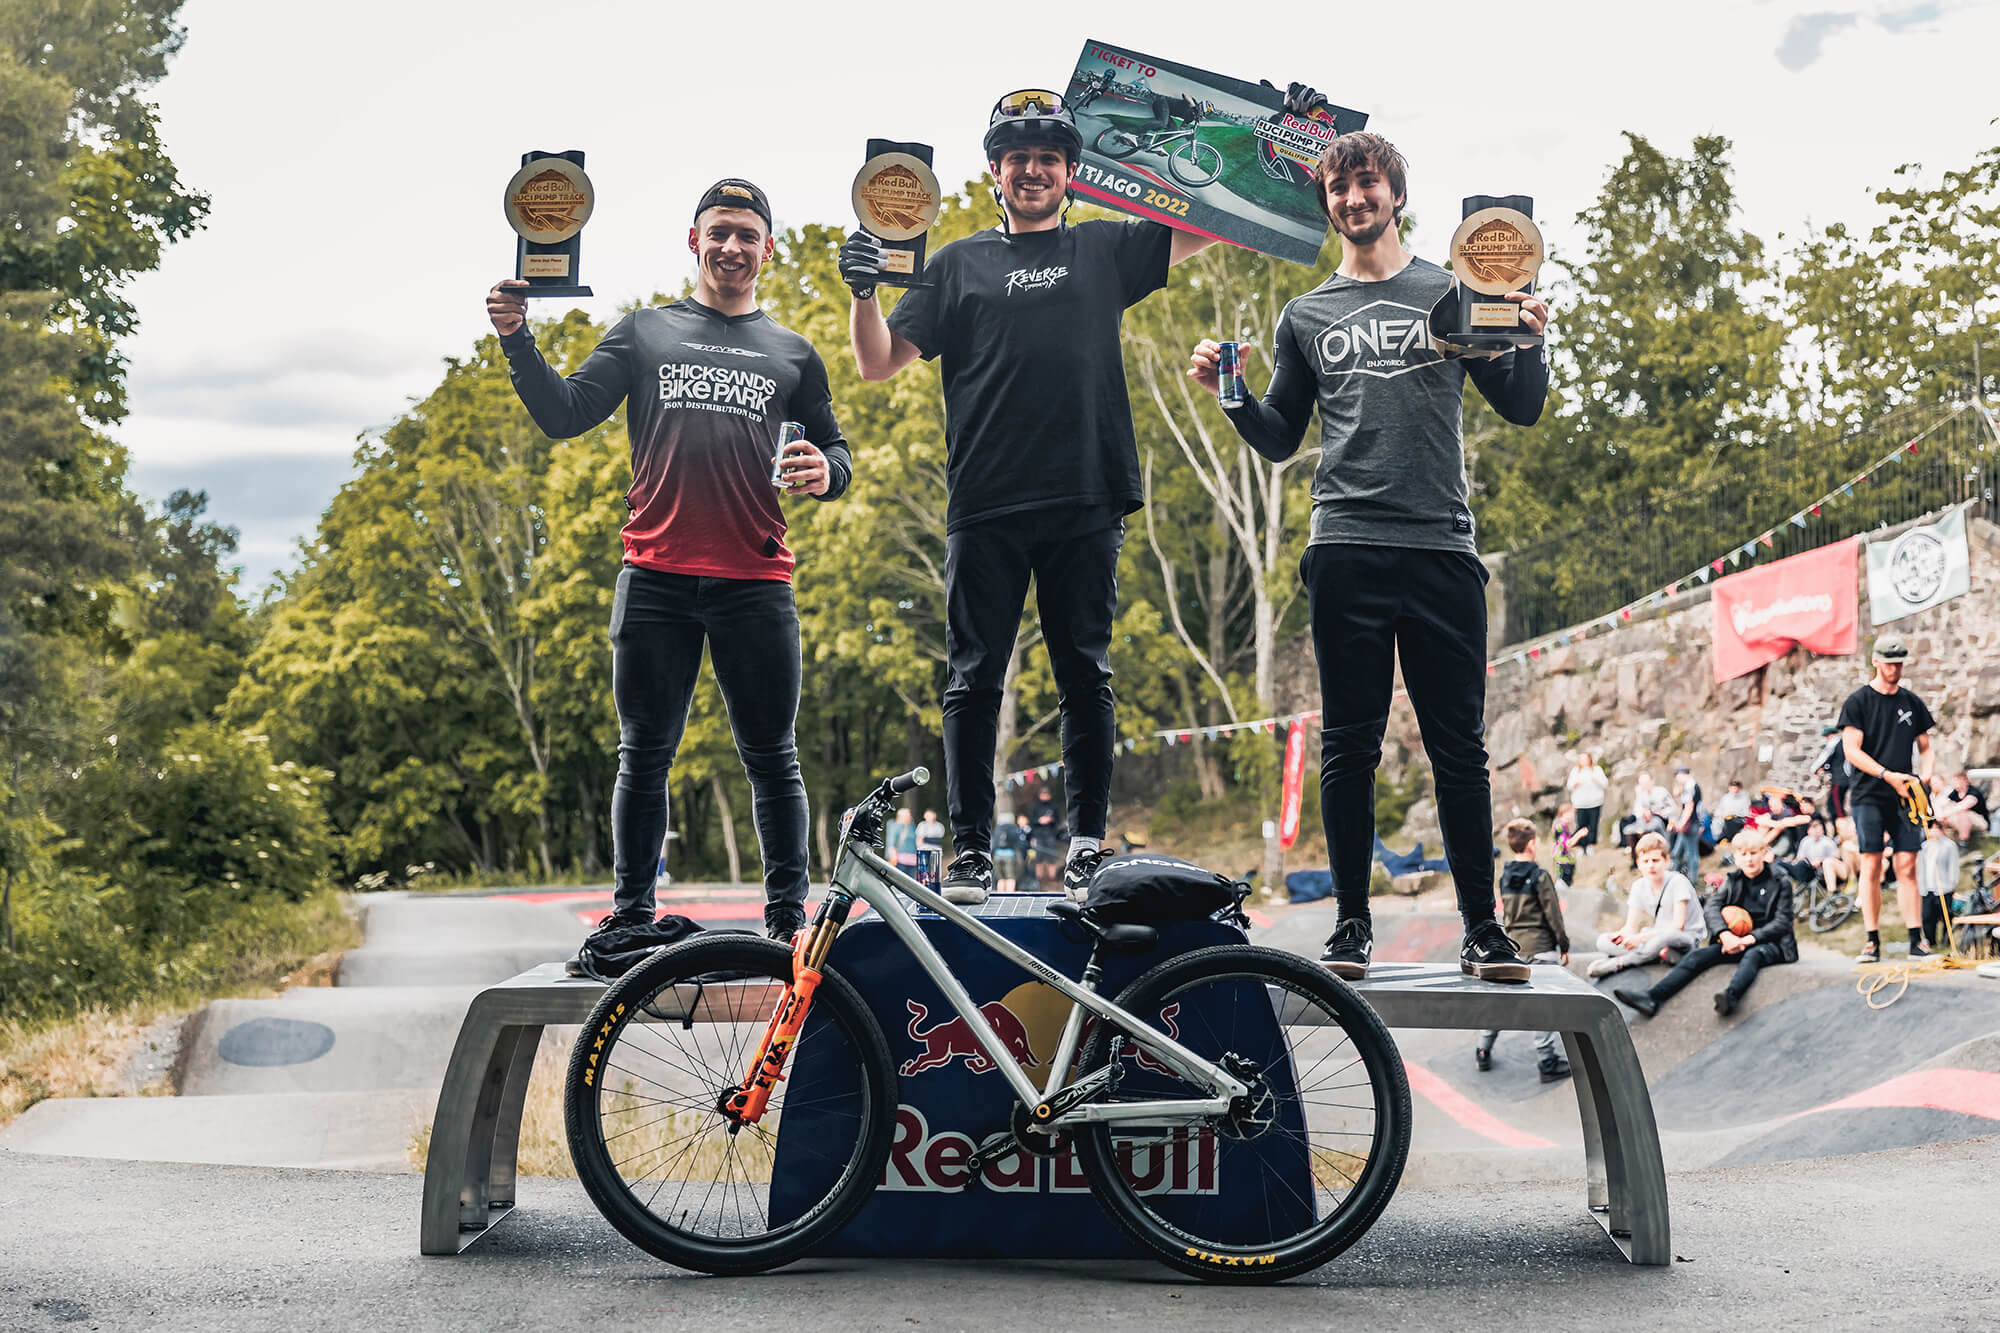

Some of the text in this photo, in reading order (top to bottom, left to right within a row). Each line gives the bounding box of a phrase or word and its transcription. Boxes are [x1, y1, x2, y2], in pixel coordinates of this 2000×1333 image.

[1089, 45, 1157, 78] TICKET TO
[1263, 122, 1284, 136] UCI
[1283, 130, 1313, 146] PUMP
[1282, 113, 1336, 141] Red Bull
[529, 182, 570, 192] Red Bull
[878, 177, 918, 189] Red Bull
[535, 193, 558, 201] PUMP
[559, 193, 585, 201] TRACK
[882, 188, 905, 197] PUMP
[906, 191, 932, 201] TRACK
[1143, 188, 1190, 217] 2022
[1476, 232, 1518, 242] Red Bull
[1481, 244, 1505, 252] PUMP
[1004, 266, 1069, 297] REVERSE
[658, 363, 777, 396] CHICKSANDS
[713, 382, 772, 415] PARK
[664, 401, 763, 423] ISON DISTRIBUTION LTD
[1027, 960, 1061, 981] RADON
[584, 1002, 625, 1087] MAXXIS
[1185, 1247, 1277, 1266] MAXXIS
